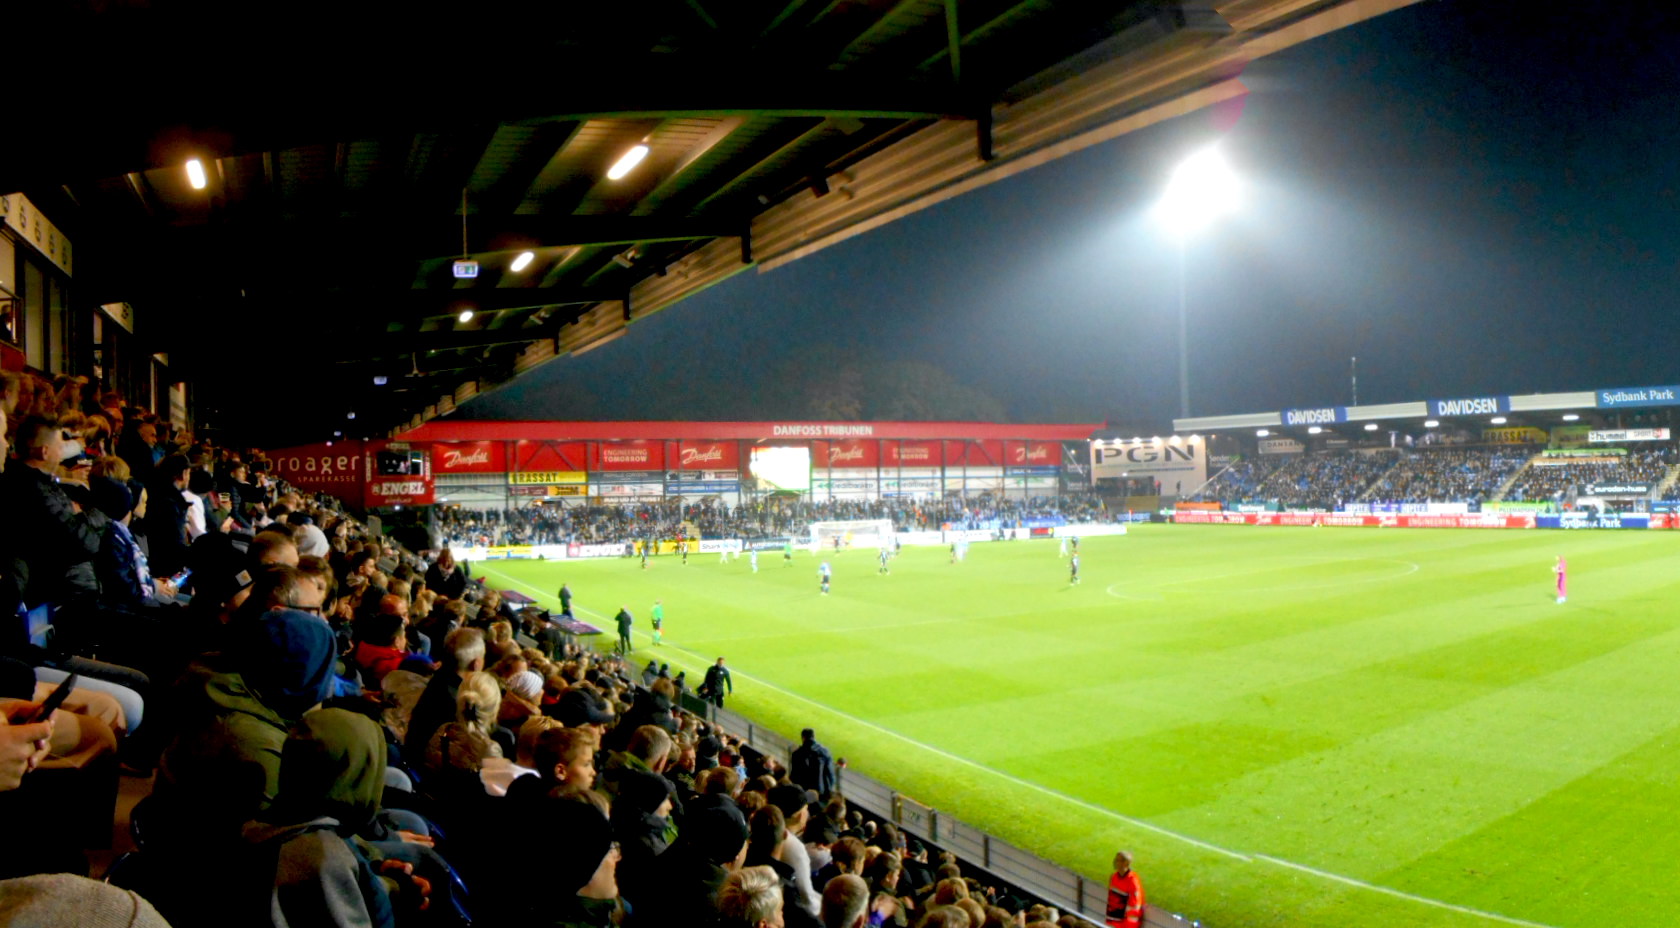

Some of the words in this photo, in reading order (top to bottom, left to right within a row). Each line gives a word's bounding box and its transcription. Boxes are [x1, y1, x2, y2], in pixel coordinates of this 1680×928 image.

[1602, 390, 1647, 405] Sydbank
[1650, 389, 1674, 401] Park
[1439, 398, 1497, 416] DAVIDSEN
[1287, 409, 1335, 424] DAVIDSEN
[773, 425, 821, 435] DANFOSS
[823, 425, 873, 435] TRIBUNEN
[1095, 445, 1194, 464] PGN
[381, 481, 424, 496] ENGEL
[1600, 518, 1621, 527] Park
